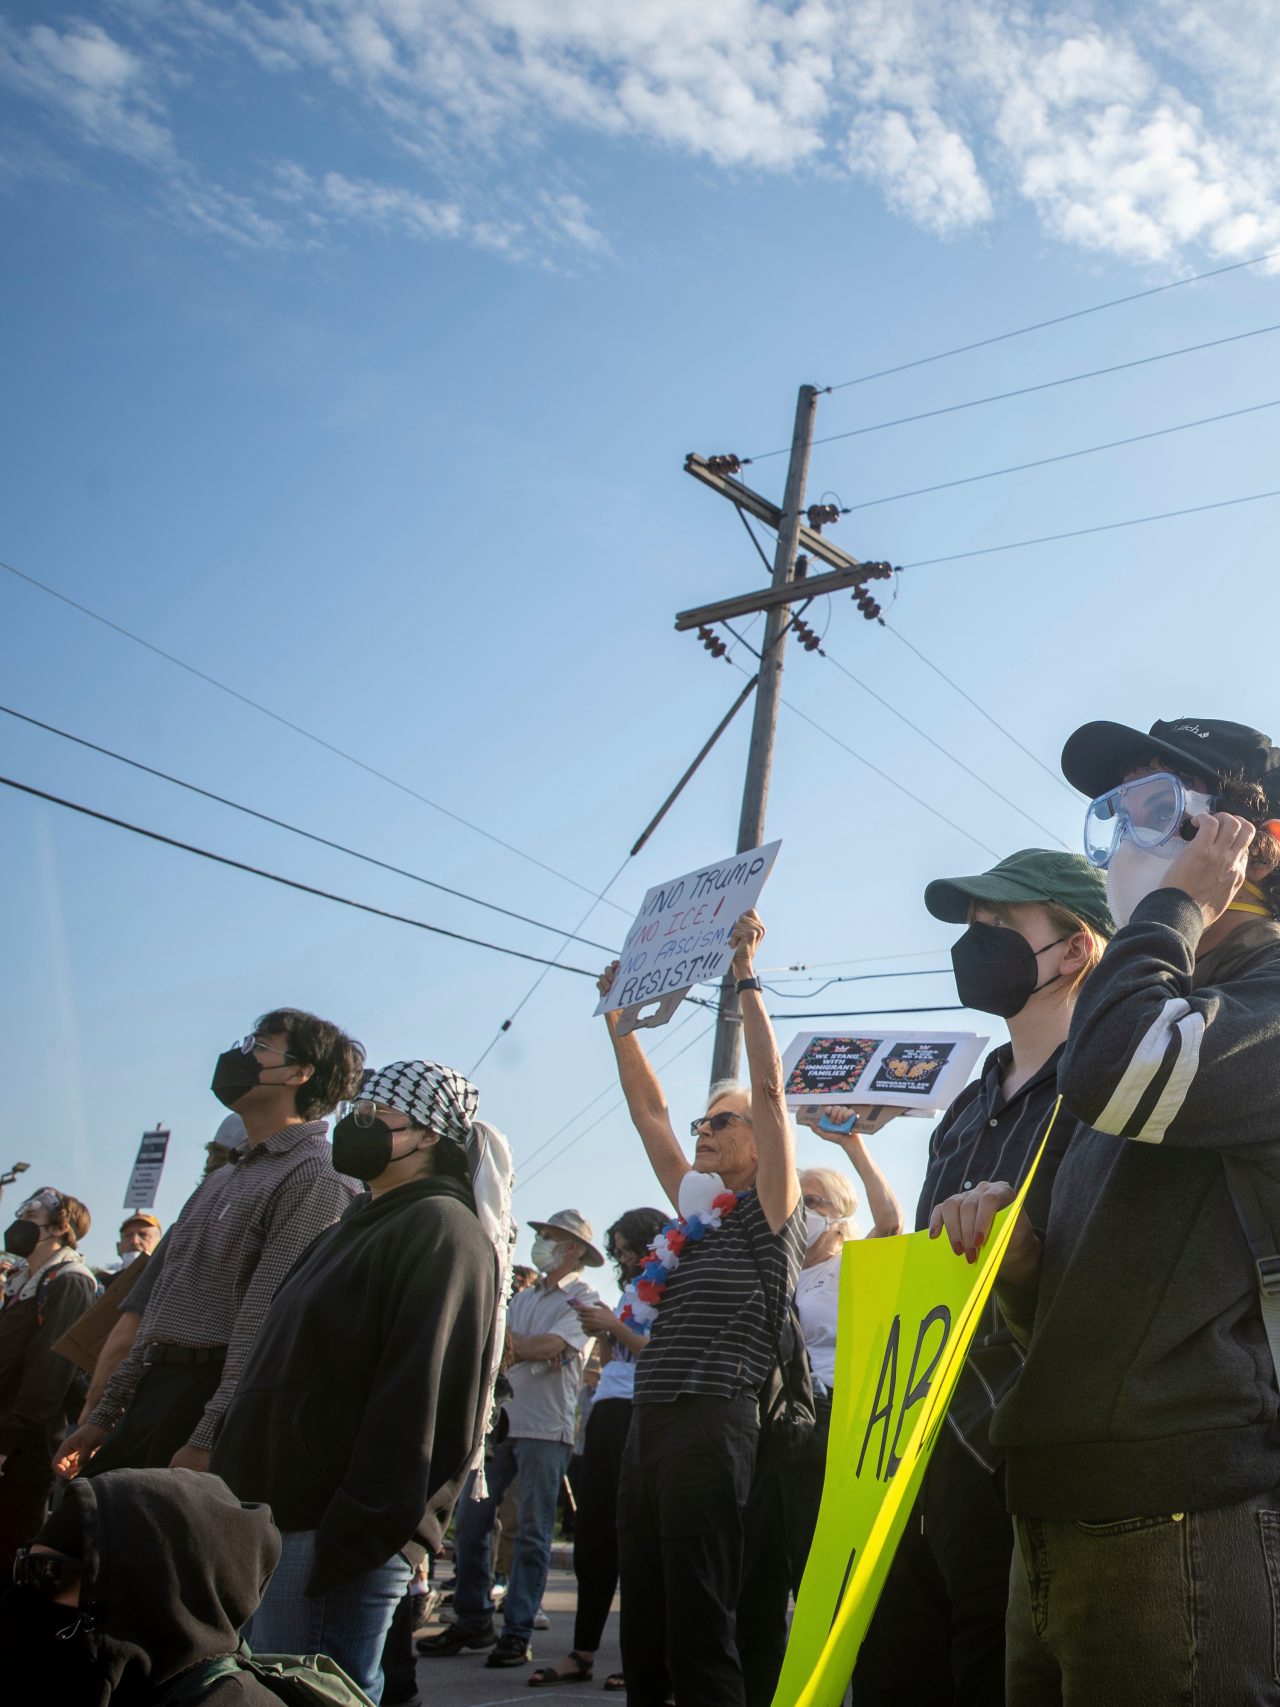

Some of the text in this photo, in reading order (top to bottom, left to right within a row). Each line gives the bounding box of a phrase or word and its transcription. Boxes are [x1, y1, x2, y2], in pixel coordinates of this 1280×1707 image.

[656, 857, 765, 914] NO TRUMP
[639, 896, 726, 945] NO ICE!
[617, 951, 724, 1008] RESIST!!!
[622, 952, 648, 975] NO
